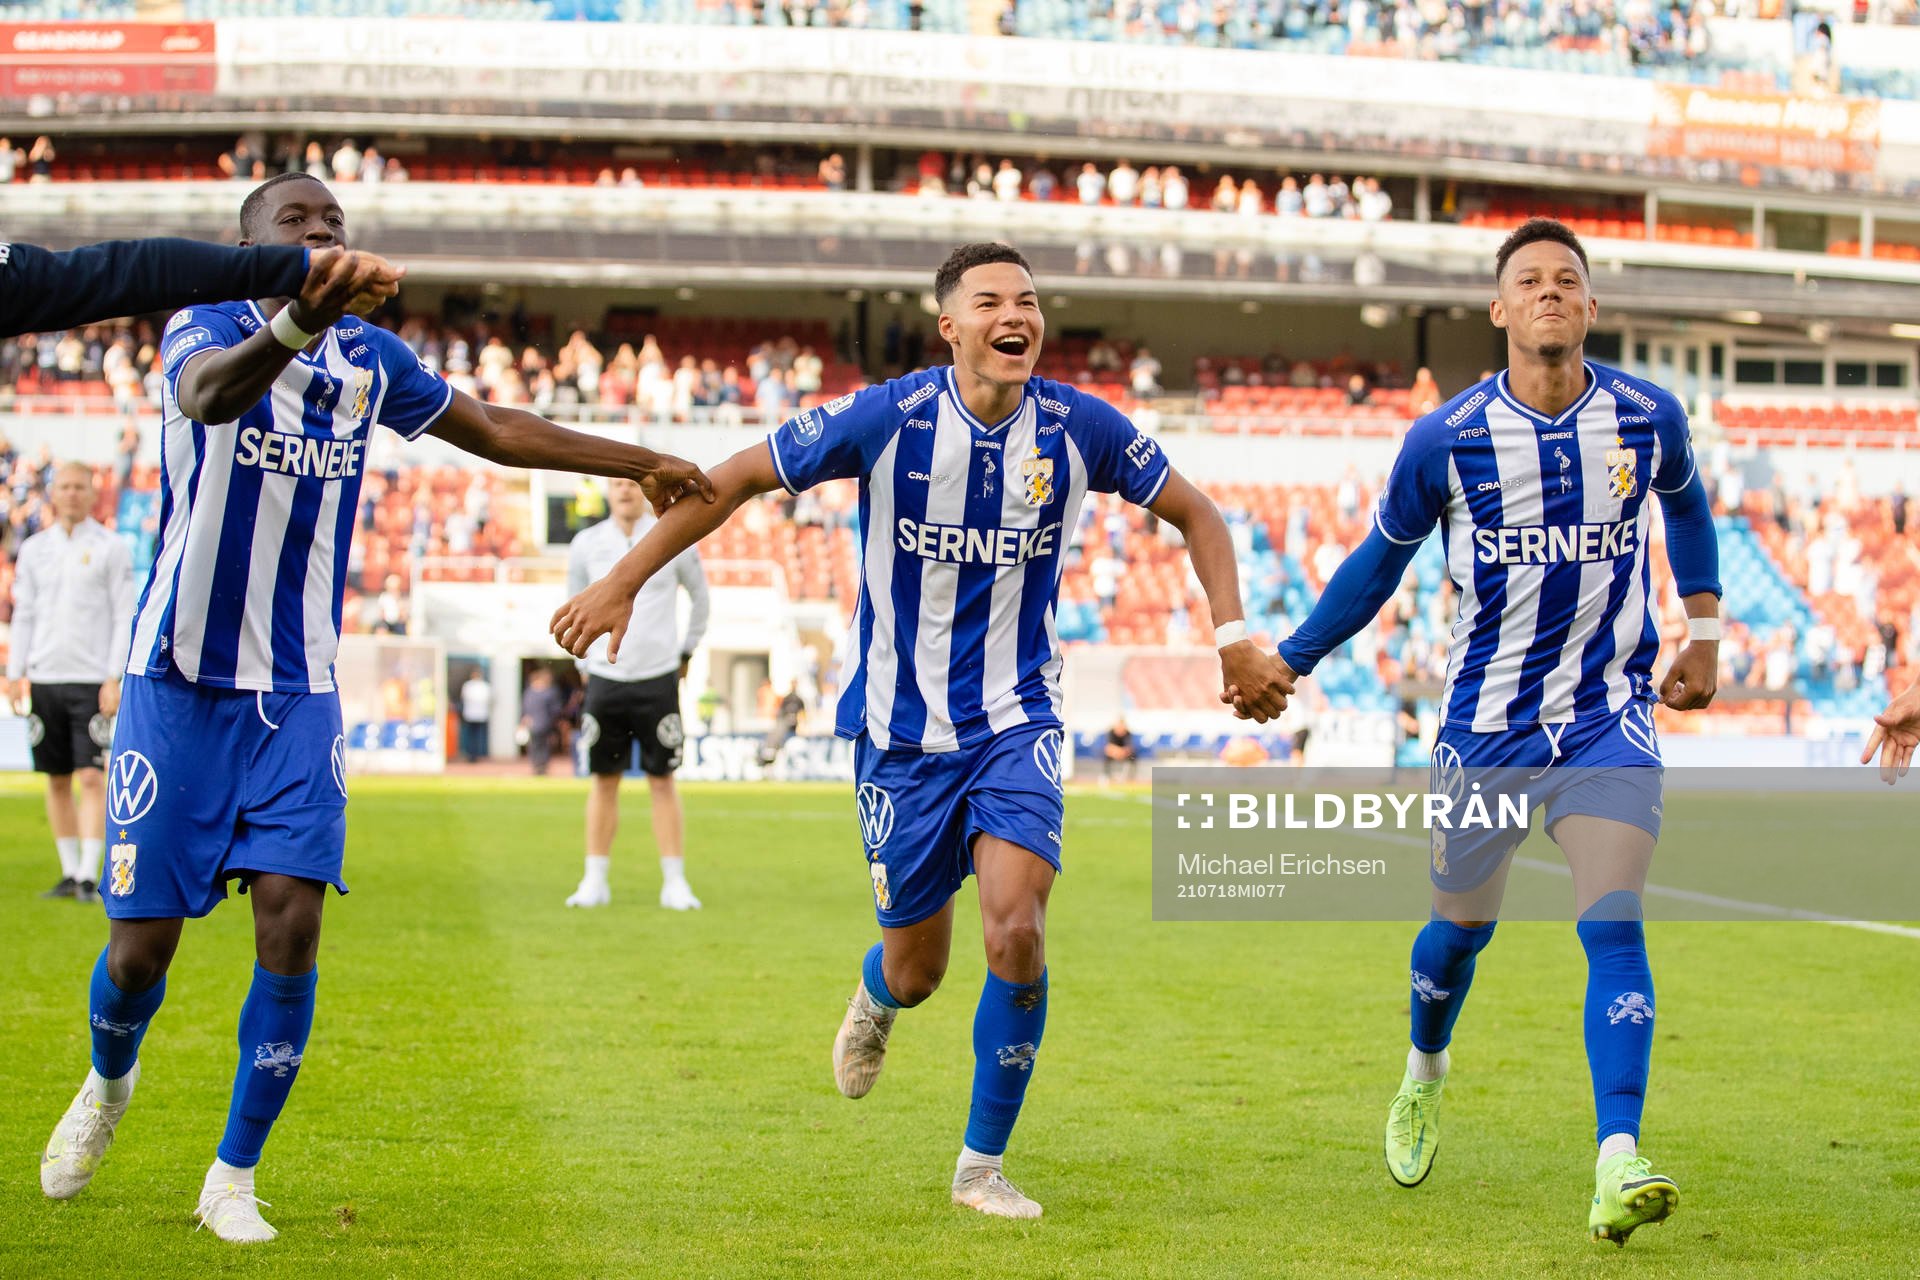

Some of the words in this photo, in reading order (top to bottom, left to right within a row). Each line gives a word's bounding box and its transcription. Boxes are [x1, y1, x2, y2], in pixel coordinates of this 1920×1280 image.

[897, 382, 936, 411] FAMECO
[1445, 391, 1486, 427] FAMECO
[1612, 379, 1657, 411] FAMECO
[1541, 432, 1574, 441] SERNEKE
[1478, 479, 1512, 491] CRAFT
[898, 517, 1057, 566] SERNEKE
[1475, 518, 1636, 564] SERNEKE
